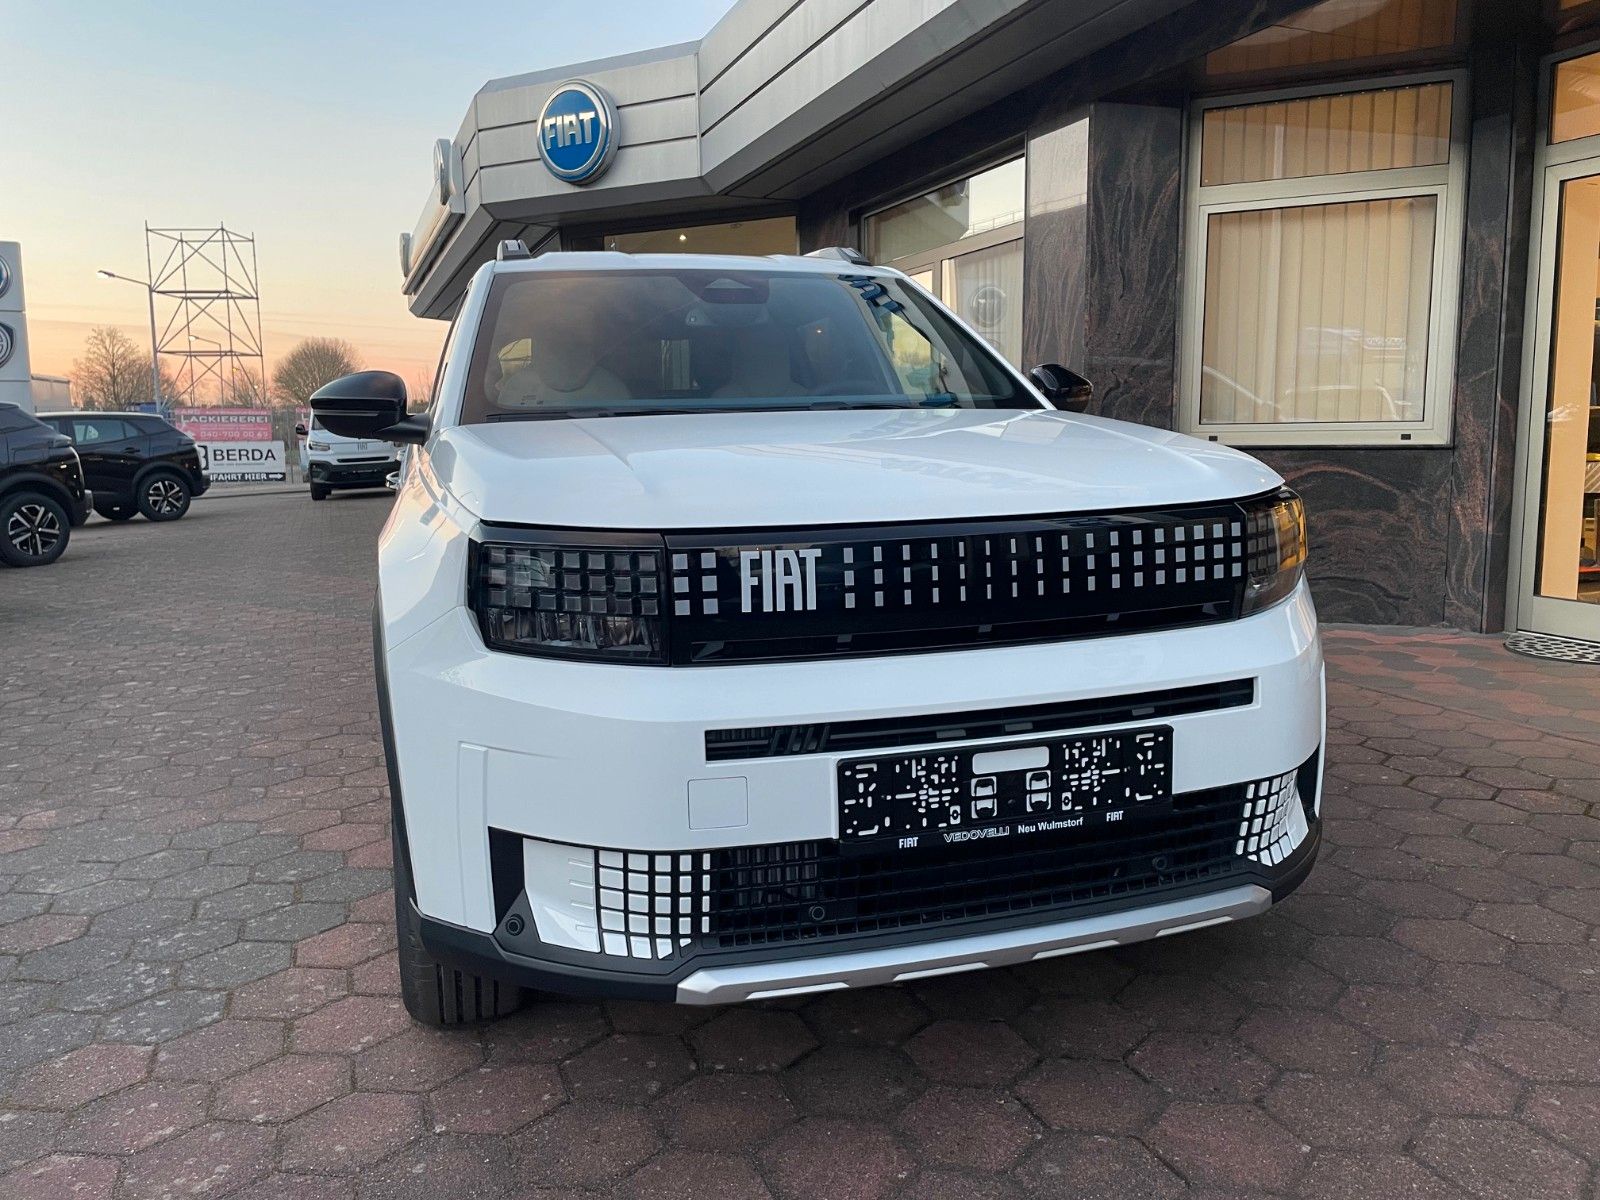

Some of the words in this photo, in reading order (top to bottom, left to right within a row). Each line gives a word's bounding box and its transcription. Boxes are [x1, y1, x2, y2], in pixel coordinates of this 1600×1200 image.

[544, 111, 595, 150] FIAT
[181, 415, 268, 423] LACKIEREREI
[213, 449, 276, 461] BERDA
[740, 549, 822, 613] FIAT
[898, 837, 919, 849] FIAT
[943, 826, 1010, 843] VEDOVELLI
[1018, 825, 1036, 834] Neu
[1038, 816, 1084, 831] Wulmstorf
[1106, 810, 1124, 822] FIAT
